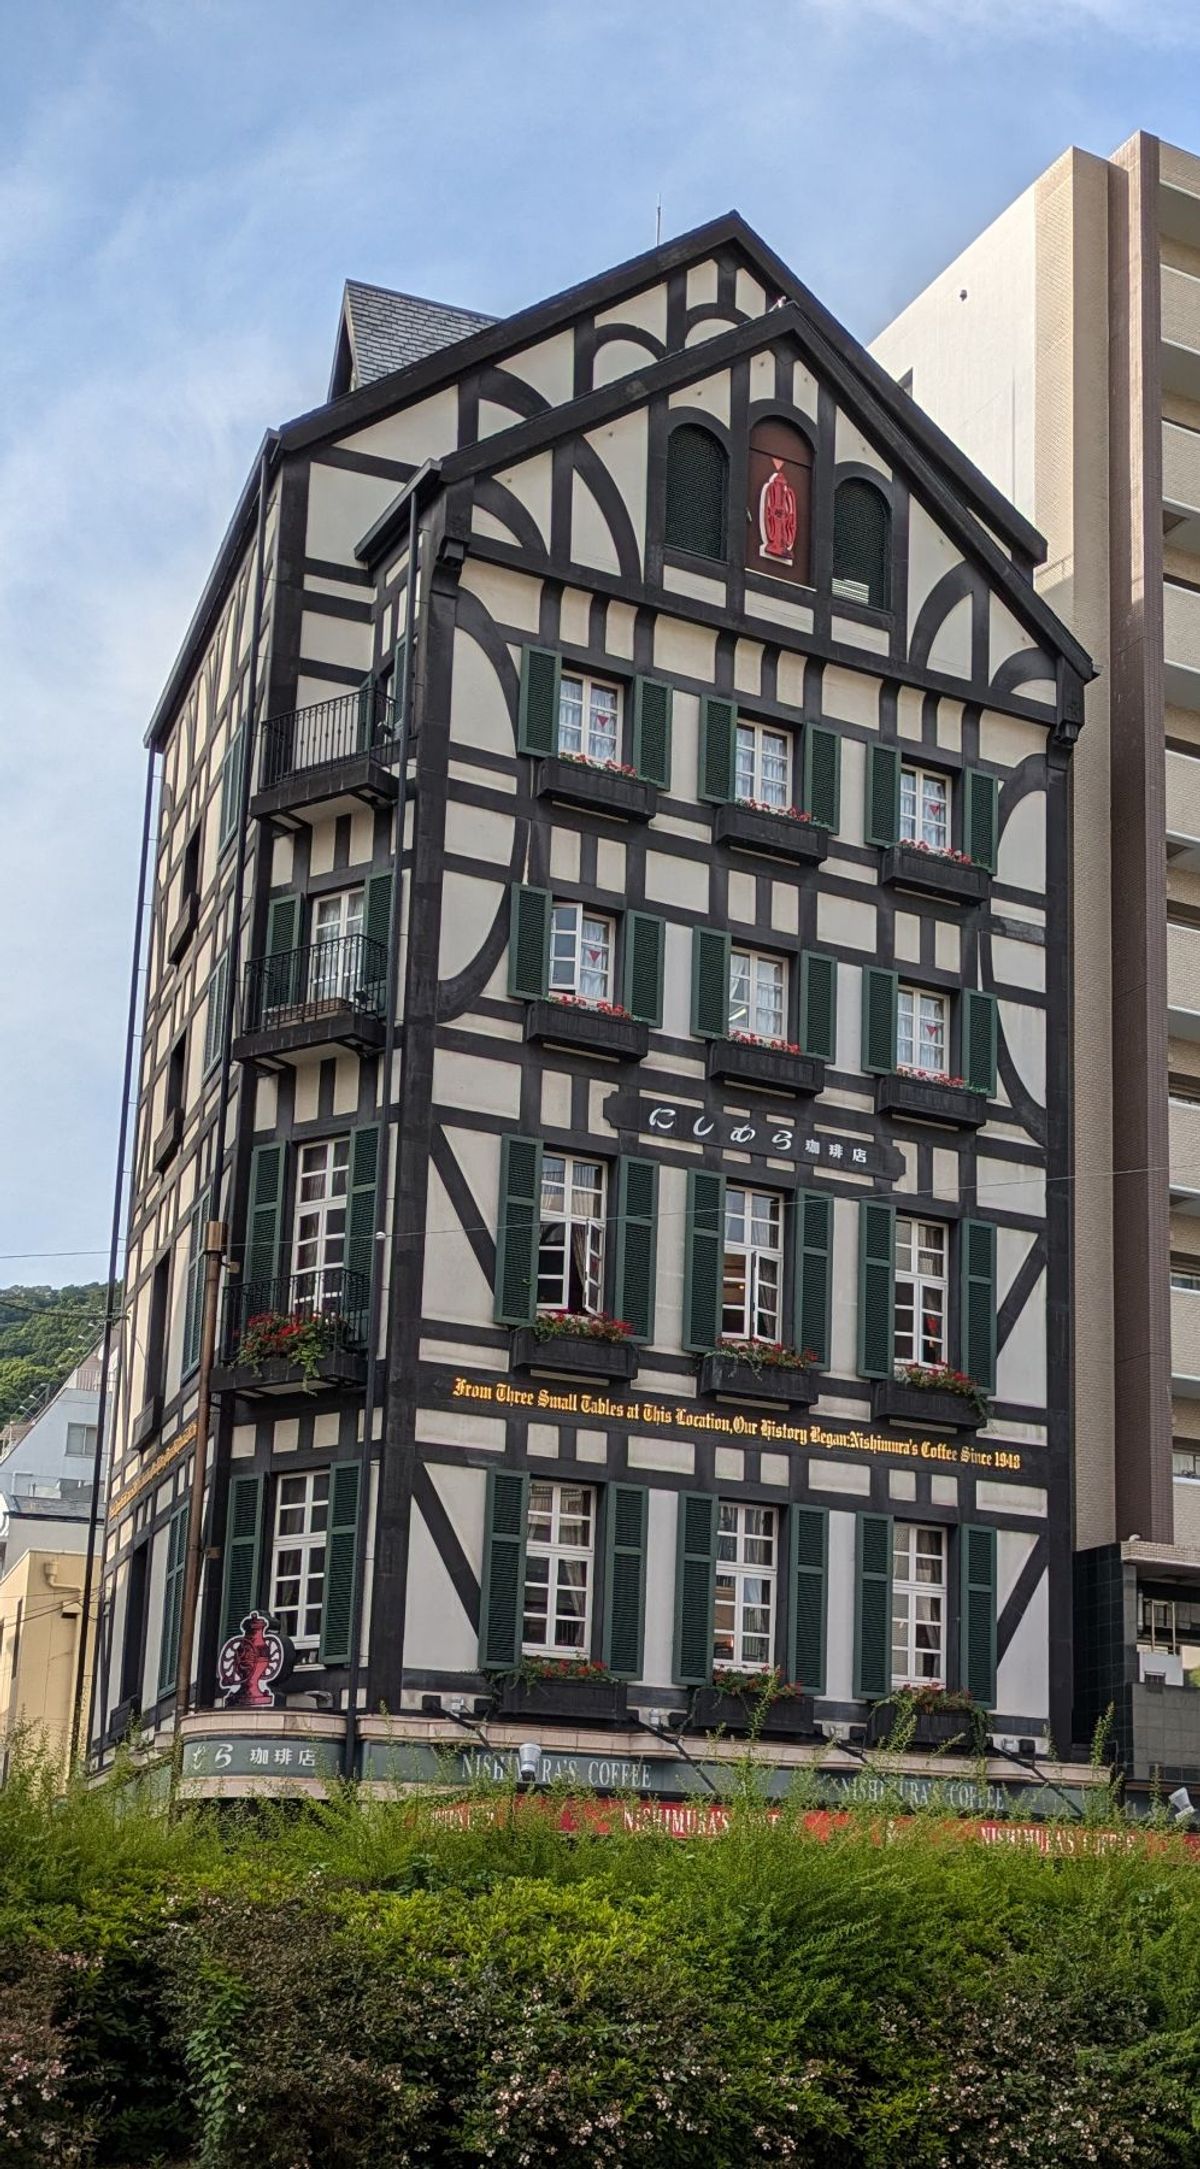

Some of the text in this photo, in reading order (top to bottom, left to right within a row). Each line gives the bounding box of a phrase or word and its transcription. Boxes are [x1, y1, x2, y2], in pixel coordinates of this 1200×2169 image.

[452, 1377, 492, 1401] From
[496, 1383, 534, 1407] Three
[537, 1389, 578, 1412] Small
[580, 1394, 624, 1418] Tables
[626, 1406, 640, 1420] at
[643, 1403, 673, 1427] This
[760, 1420, 808, 1446] History
[920, 1441, 958, 1462] Coffee
[960, 1445, 992, 1466] Since
[994, 1451, 1021, 1469] 1948
[588, 1761, 652, 1788] COFFEE
